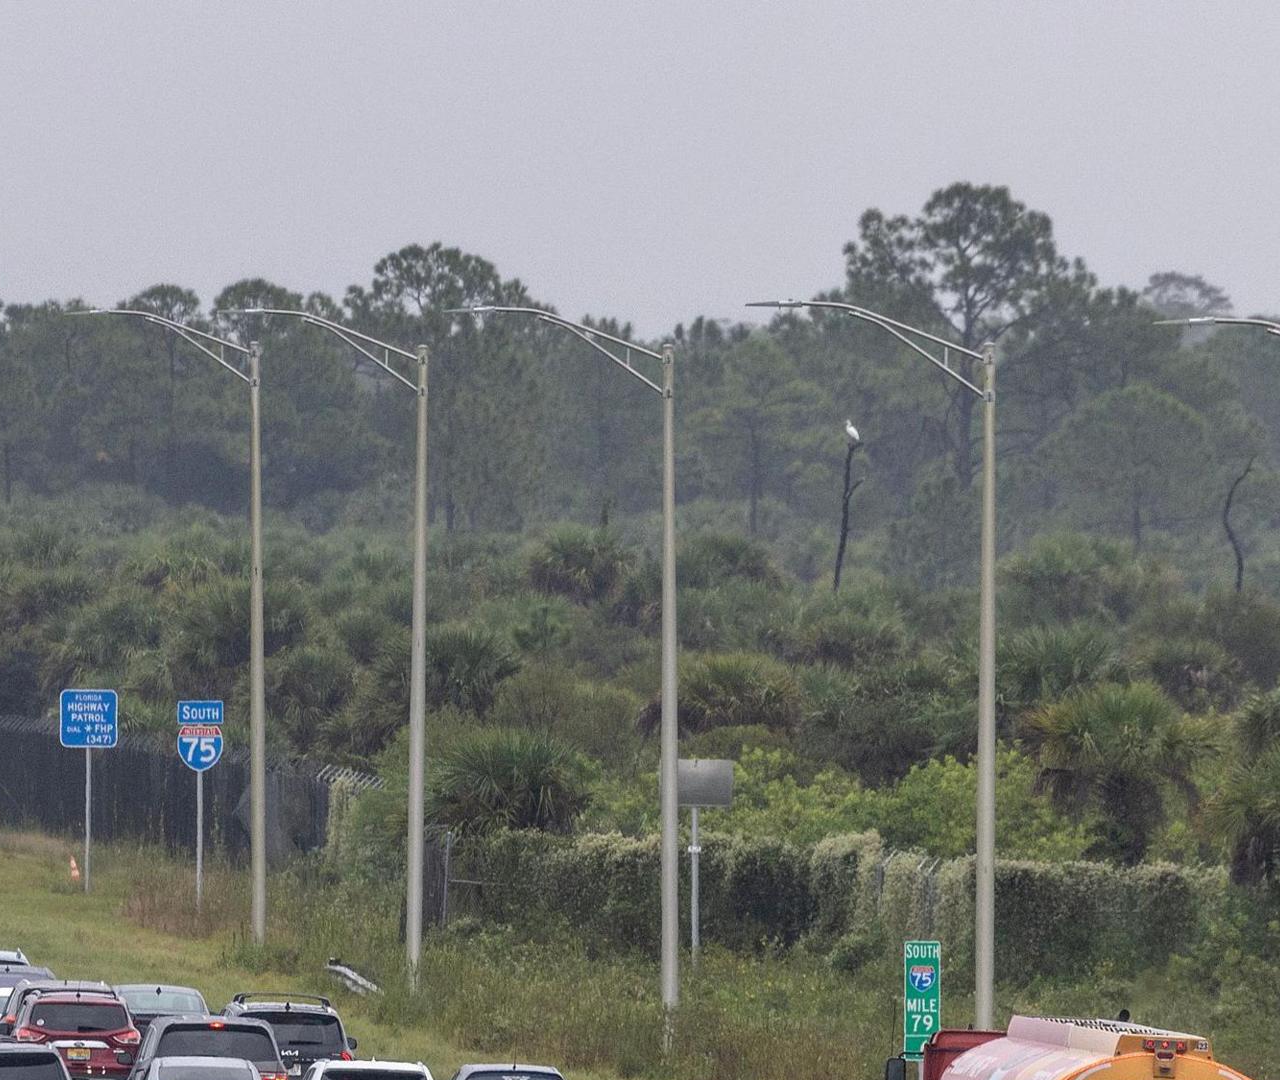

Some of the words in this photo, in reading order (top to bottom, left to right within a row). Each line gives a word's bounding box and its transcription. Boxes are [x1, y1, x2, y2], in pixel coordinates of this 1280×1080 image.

[67, 703, 109, 712] HIGHWAY
[182, 705, 219, 720] SOUTH
[71, 713, 106, 722] PATROL
[86, 735, 112, 744] (347)
[183, 738, 216, 762] 75
[906, 944, 939, 959] SOUTH
[912, 972, 932, 987] 75
[907, 998, 937, 1012] MILE
[911, 1014, 933, 1032] 79
